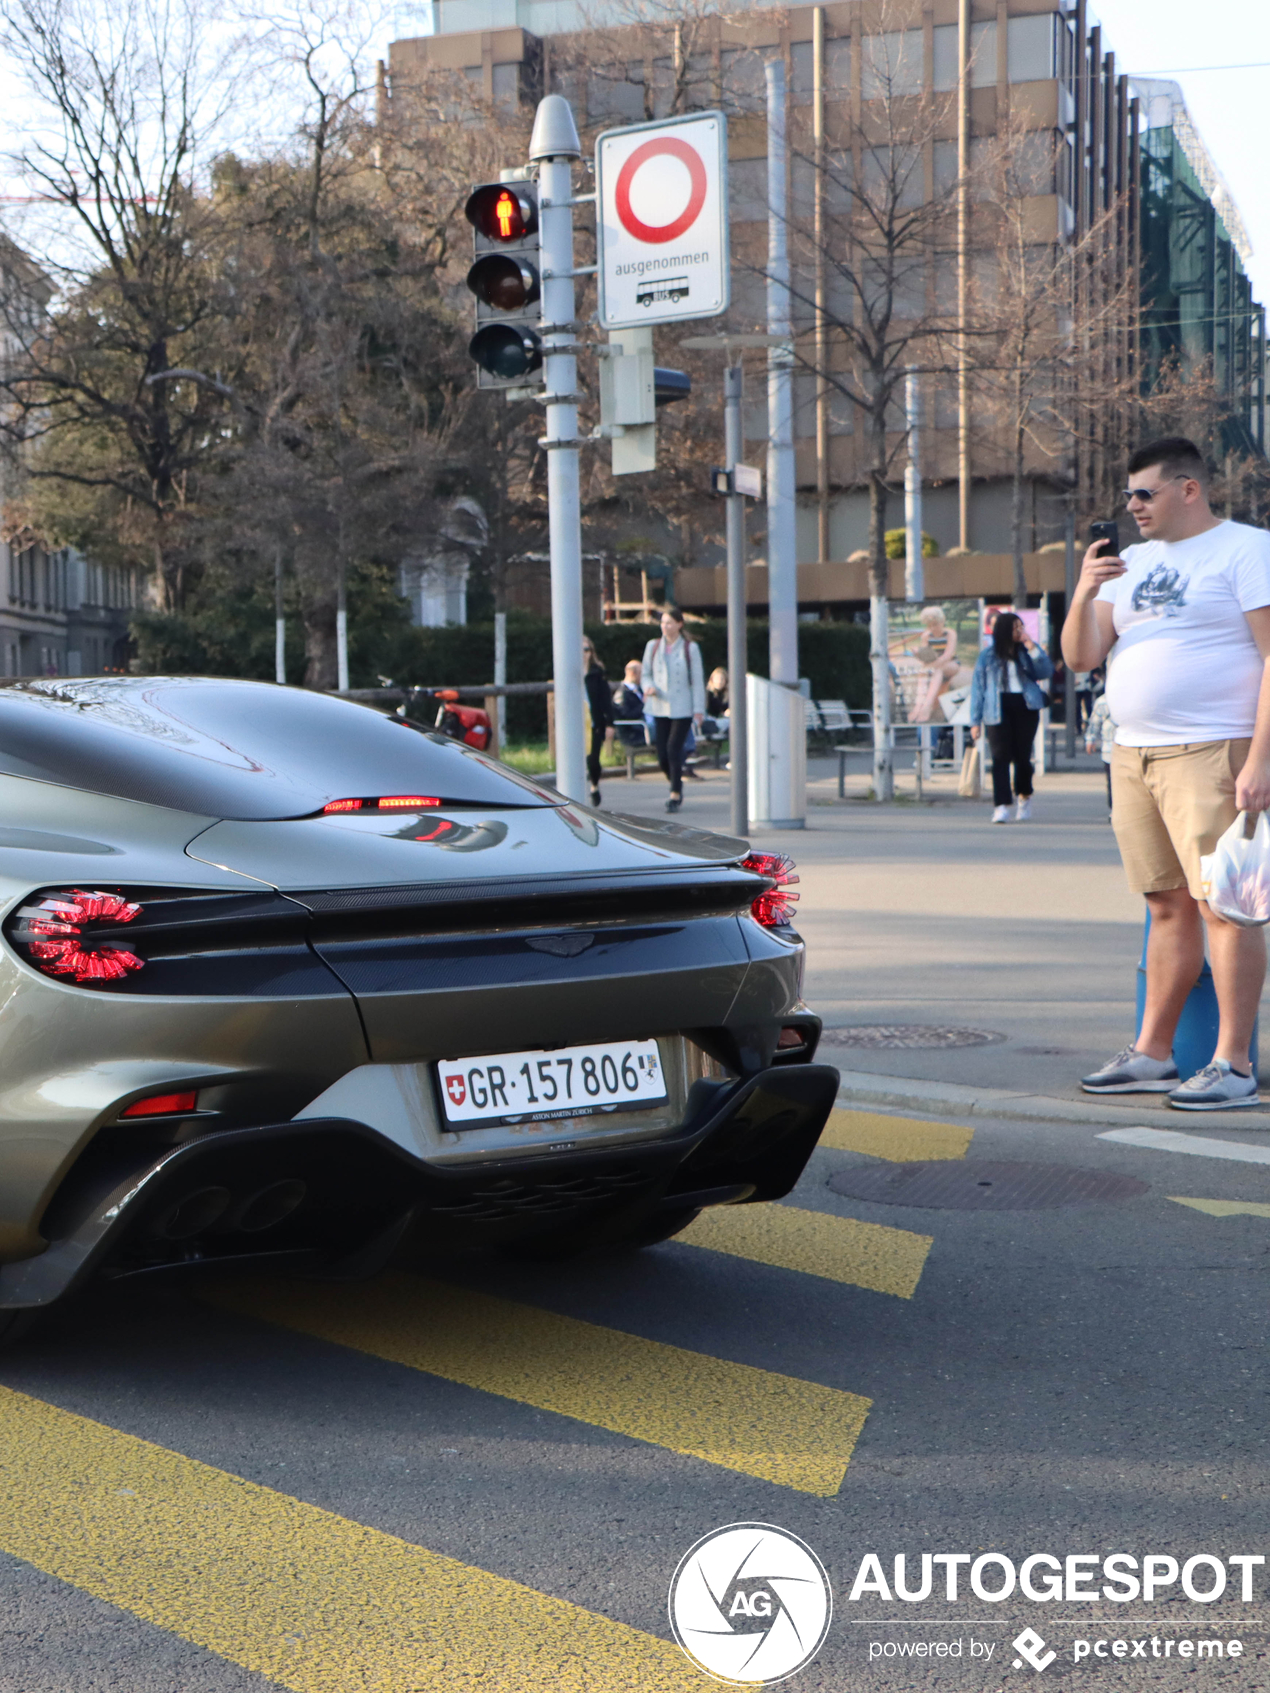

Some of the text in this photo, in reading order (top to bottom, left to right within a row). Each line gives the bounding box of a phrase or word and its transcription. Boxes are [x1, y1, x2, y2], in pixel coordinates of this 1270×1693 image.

[615, 251, 709, 277] ausgenommen
[653, 290, 670, 302] BUS
[531, 1107, 593, 1121] ASTON MARTIN ZÜRICH
